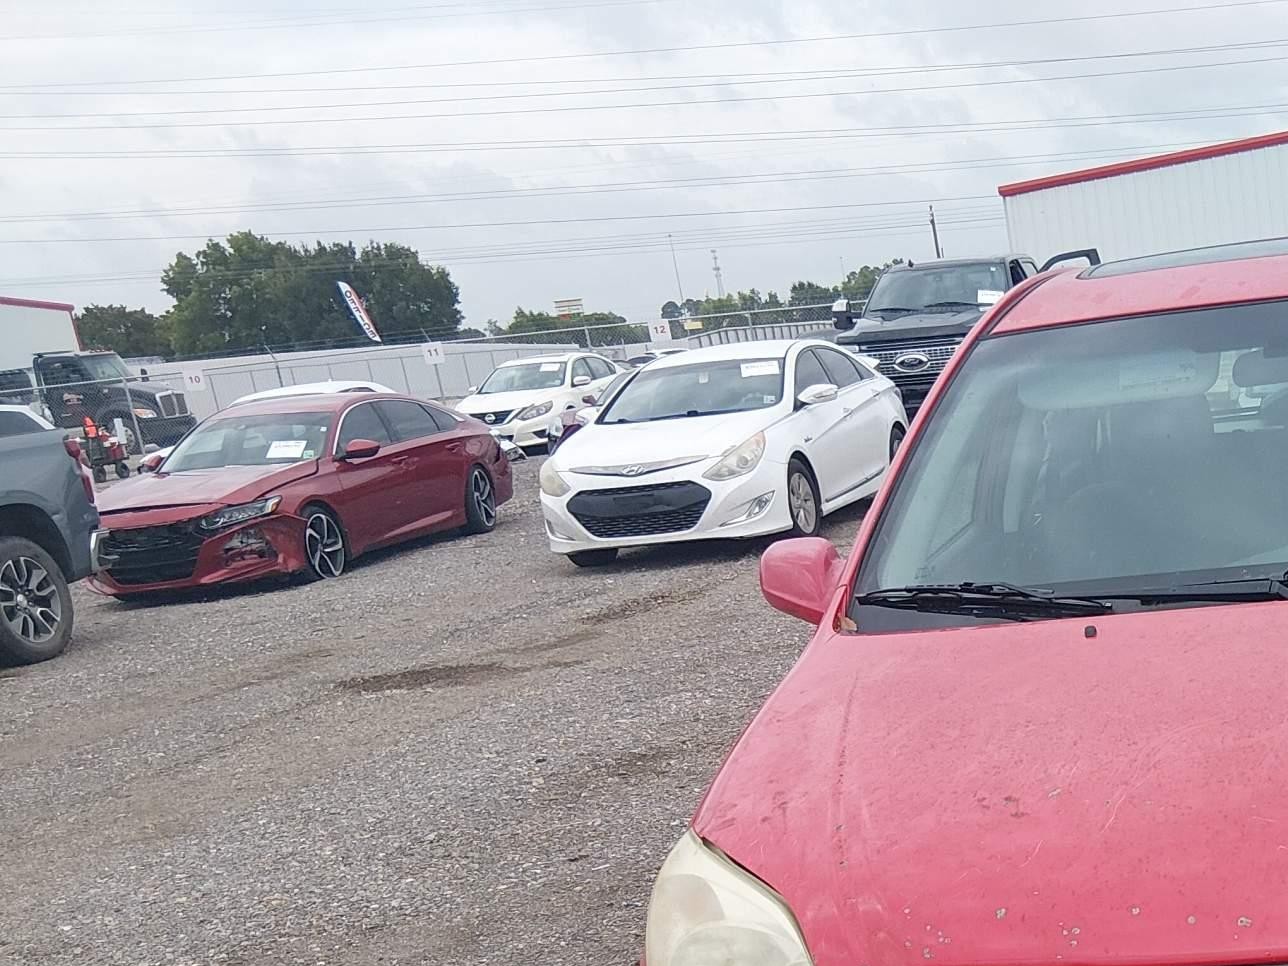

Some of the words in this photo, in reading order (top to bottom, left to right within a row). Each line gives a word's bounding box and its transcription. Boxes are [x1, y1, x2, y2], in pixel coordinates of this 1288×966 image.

[653, 325, 667, 334] 12
[427, 348, 439, 358] 11
[188, 375, 201, 385] 10
